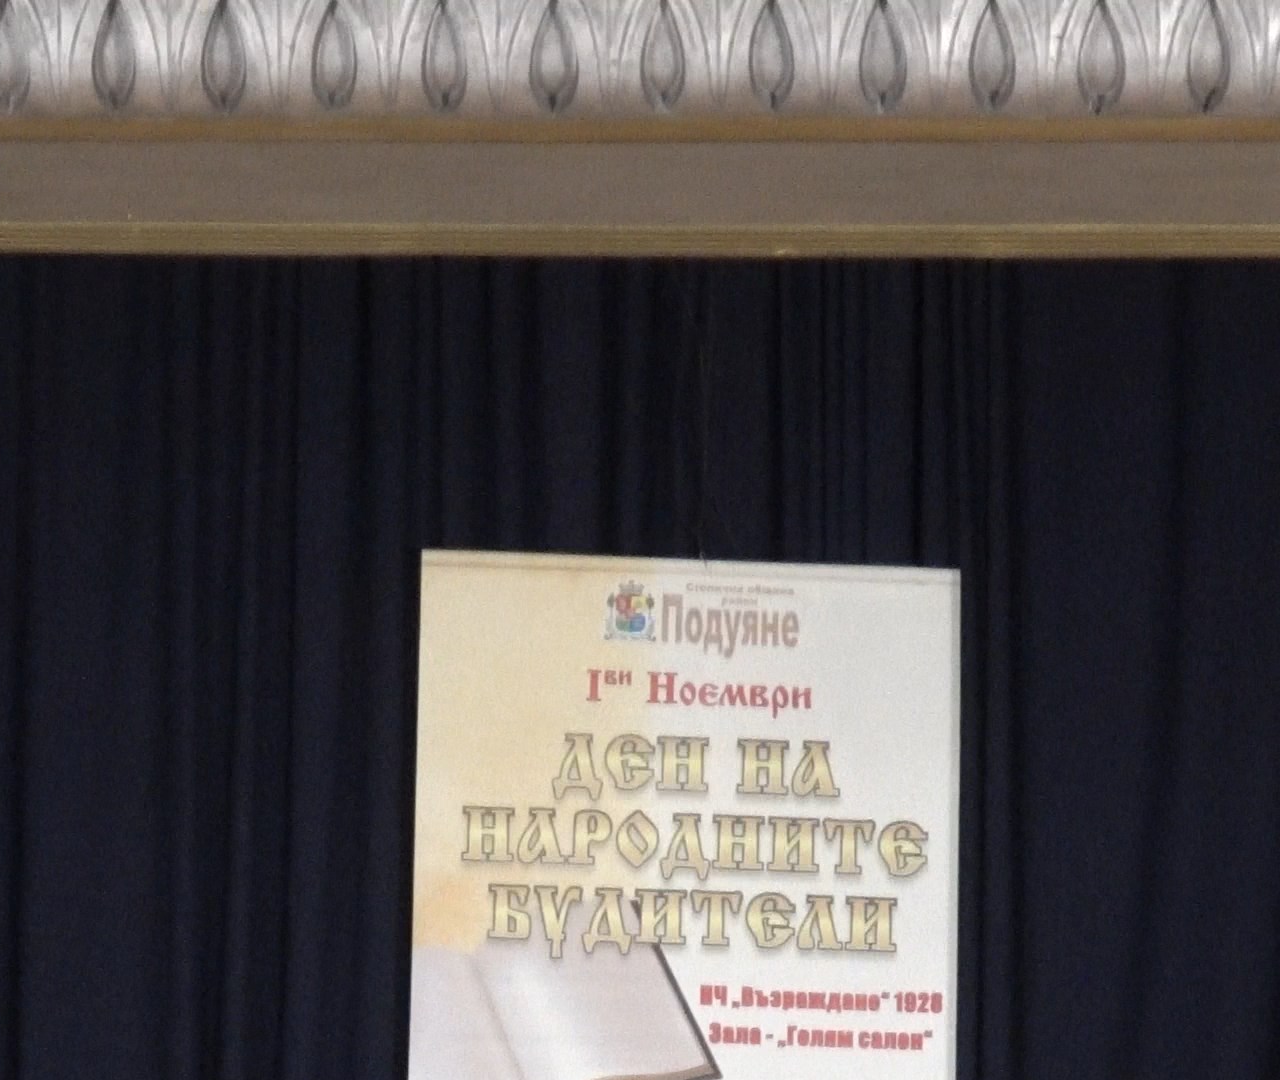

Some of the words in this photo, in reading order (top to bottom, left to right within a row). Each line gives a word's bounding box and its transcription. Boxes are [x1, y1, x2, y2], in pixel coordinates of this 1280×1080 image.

[661, 593, 799, 659] Подуяне
[552, 732, 710, 800] ДЕН
[736, 738, 841, 799] НА
[461, 805, 929, 881] НАРОДНИТЕ
[487, 883, 898, 959] БУДИТЕЛИ
[709, 1022, 760, 1045] Зала
